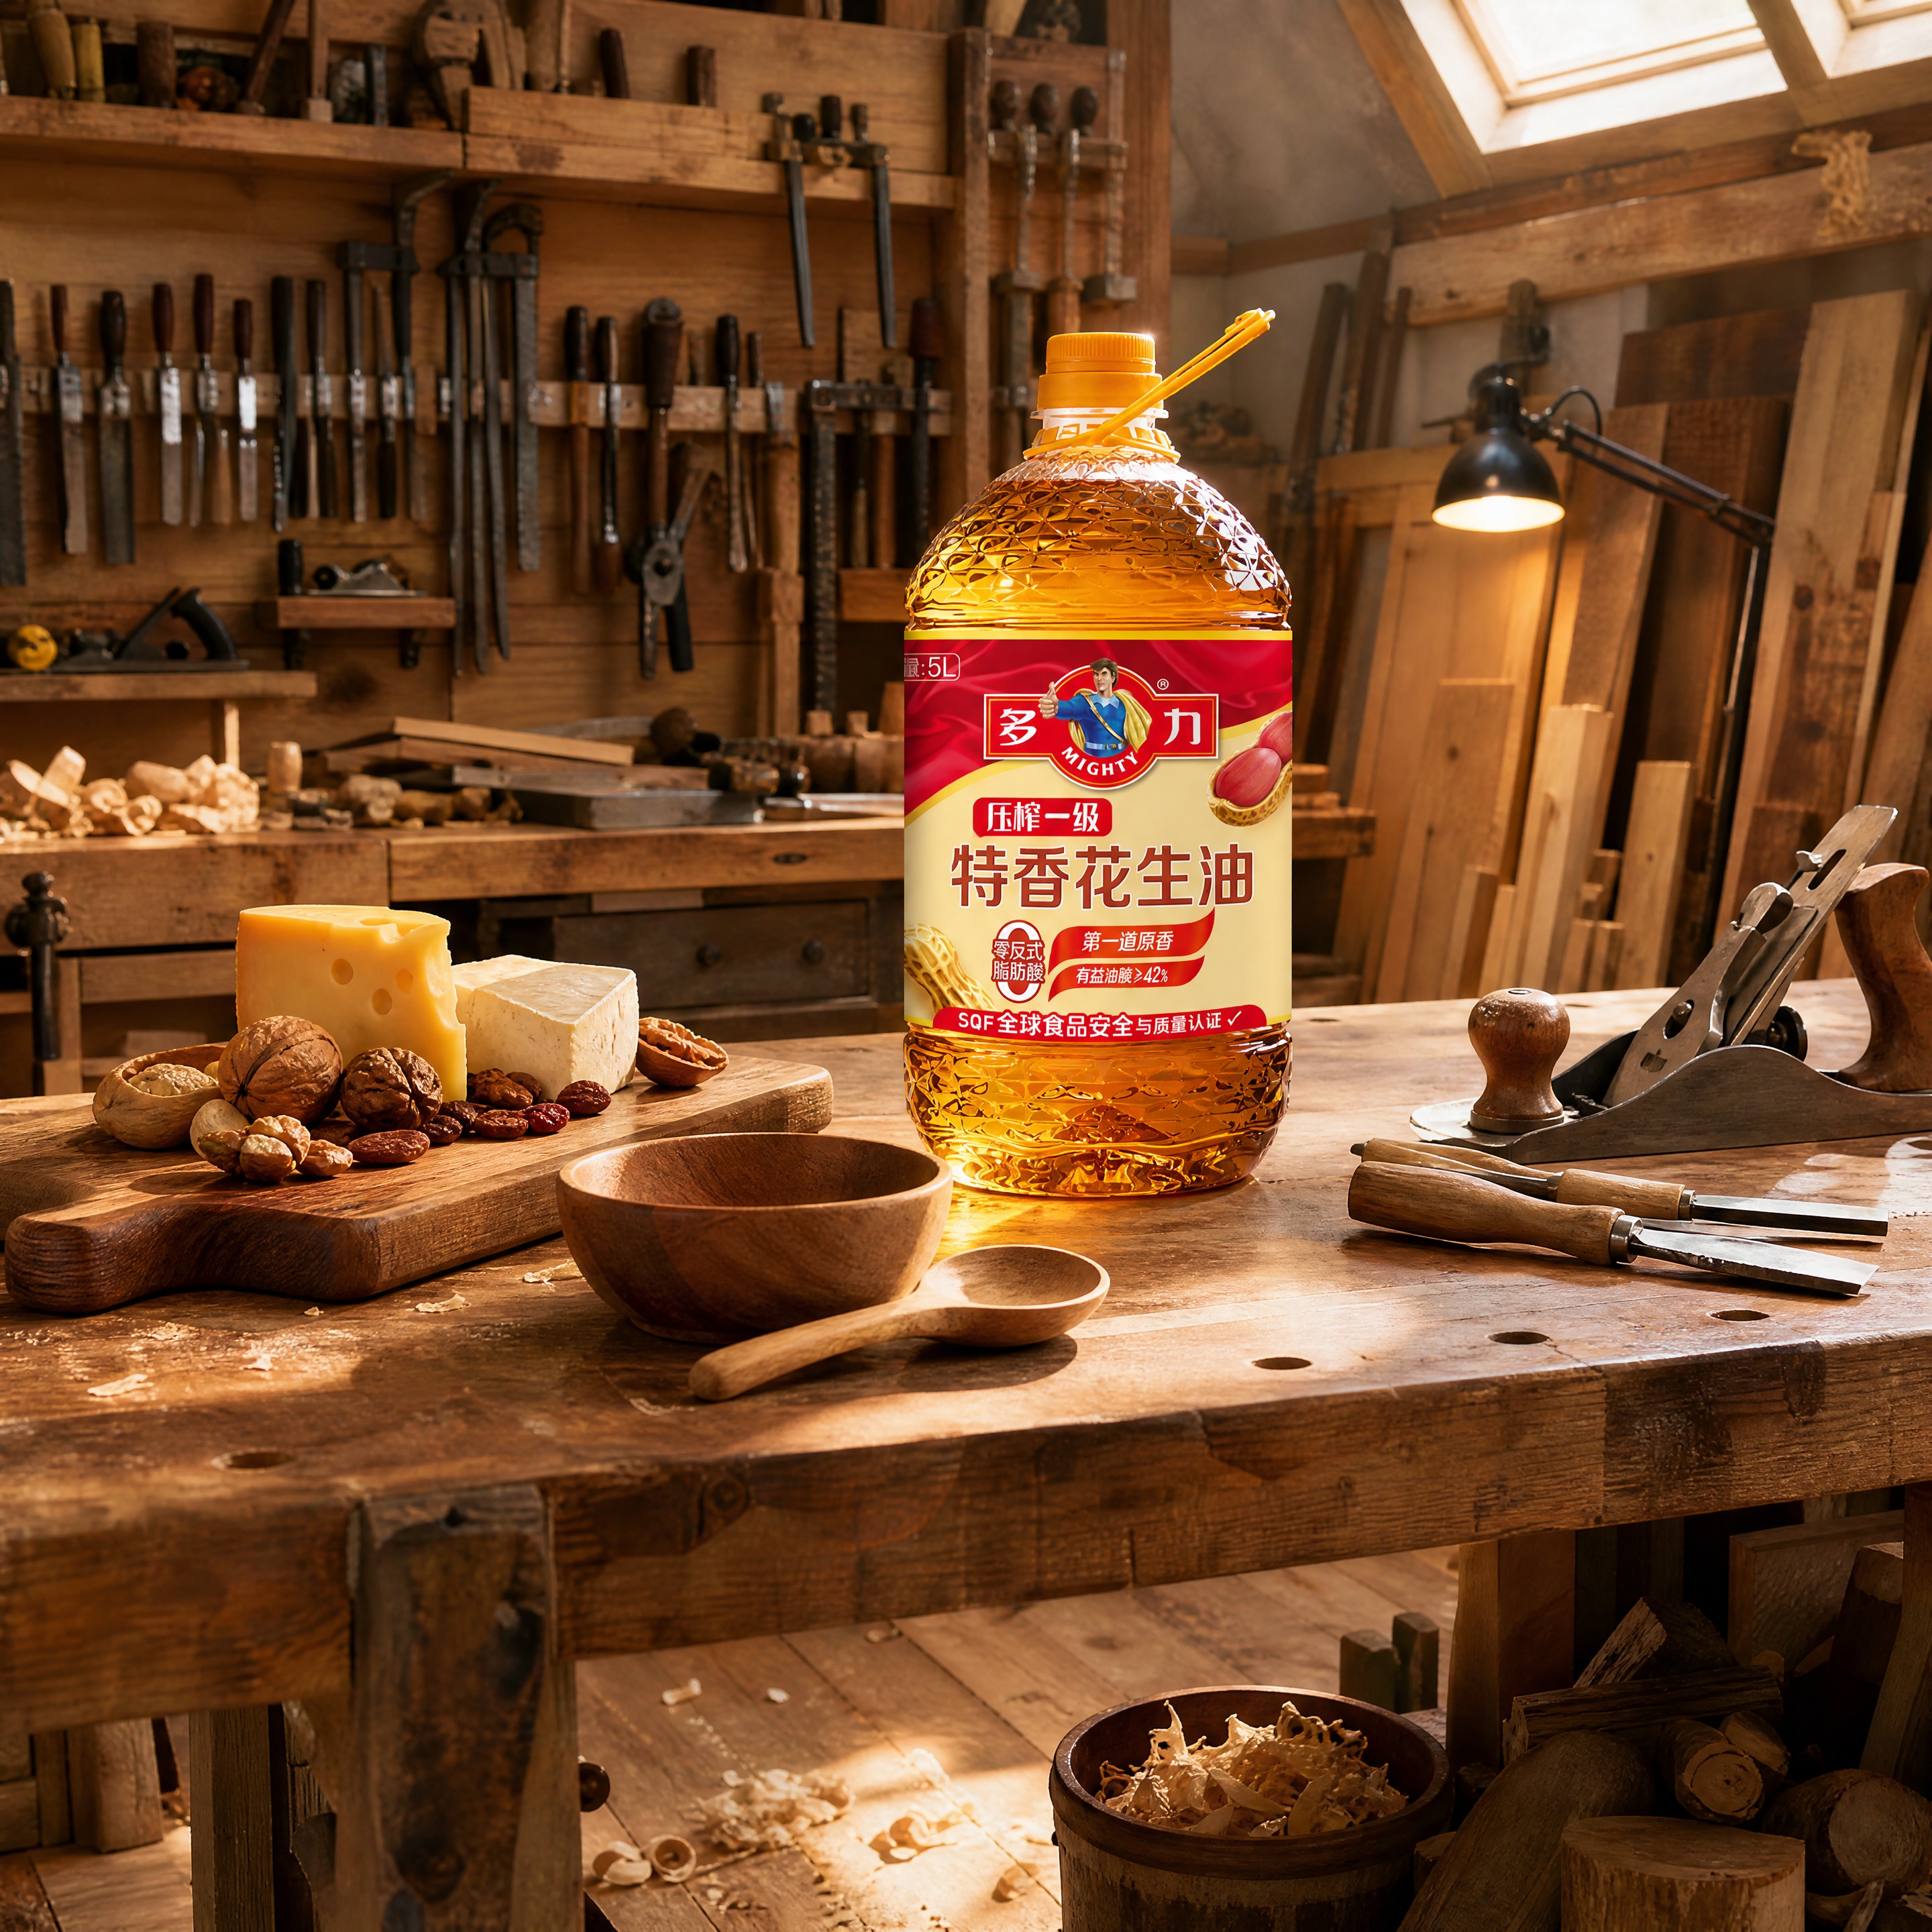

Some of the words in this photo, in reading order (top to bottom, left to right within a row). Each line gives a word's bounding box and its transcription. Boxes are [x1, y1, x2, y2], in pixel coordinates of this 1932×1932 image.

[1000, 708, 1037, 746] 多
[1164, 708, 1201, 746] 力
[1061, 747, 1138, 776] MIGHTY
[987, 801, 1099, 832] 压榨一级
[951, 843, 1254, 909] 特香花生油
[1082, 930, 1174, 952] 第一道原香
